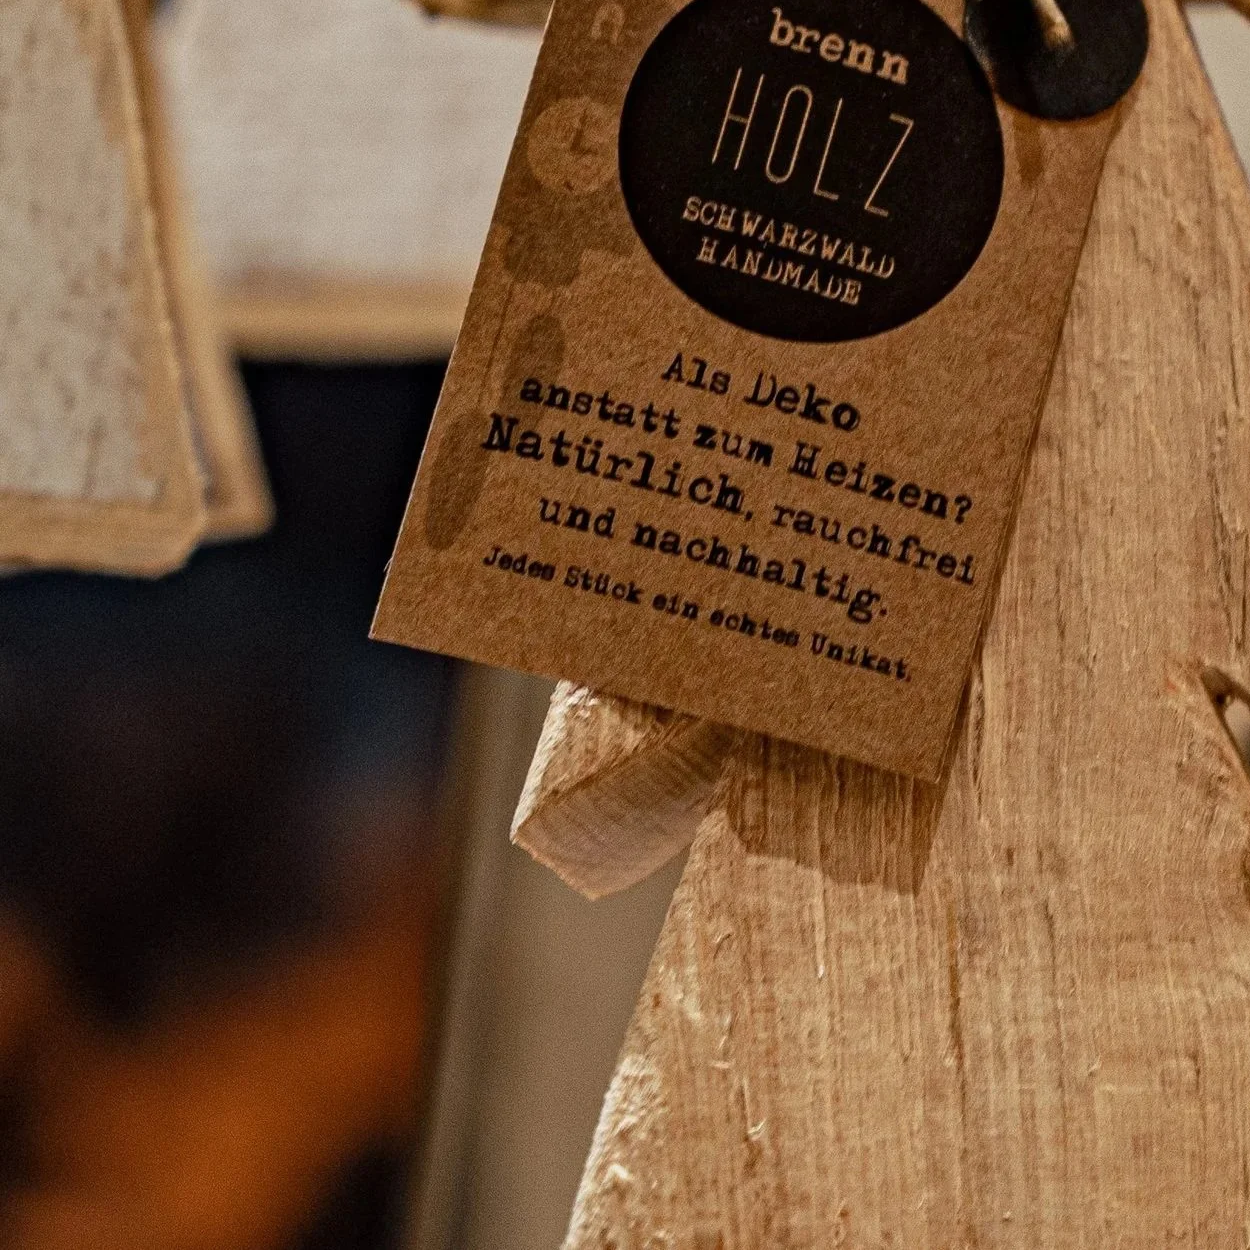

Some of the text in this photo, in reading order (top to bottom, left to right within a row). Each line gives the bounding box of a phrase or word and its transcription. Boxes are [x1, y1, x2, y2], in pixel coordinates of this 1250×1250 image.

[769, 7, 911, 85] brenn
[711, 66, 915, 218] HOLZ
[682, 195, 897, 280] SCHWARZWALD
[695, 237, 863, 307] HANDMADE
[660, 352, 861, 432] Als Deko
[477, 411, 976, 586] Natürlich, rauchfrei
[519, 376, 974, 525] anstatt zum Heizen?
[482, 546, 557, 582] Jedes
[563, 564, 644, 606] Stück
[651, 592, 700, 621] ein
[708, 607, 801, 648] echtes
[538, 497, 889, 625] und nachhaltig.
